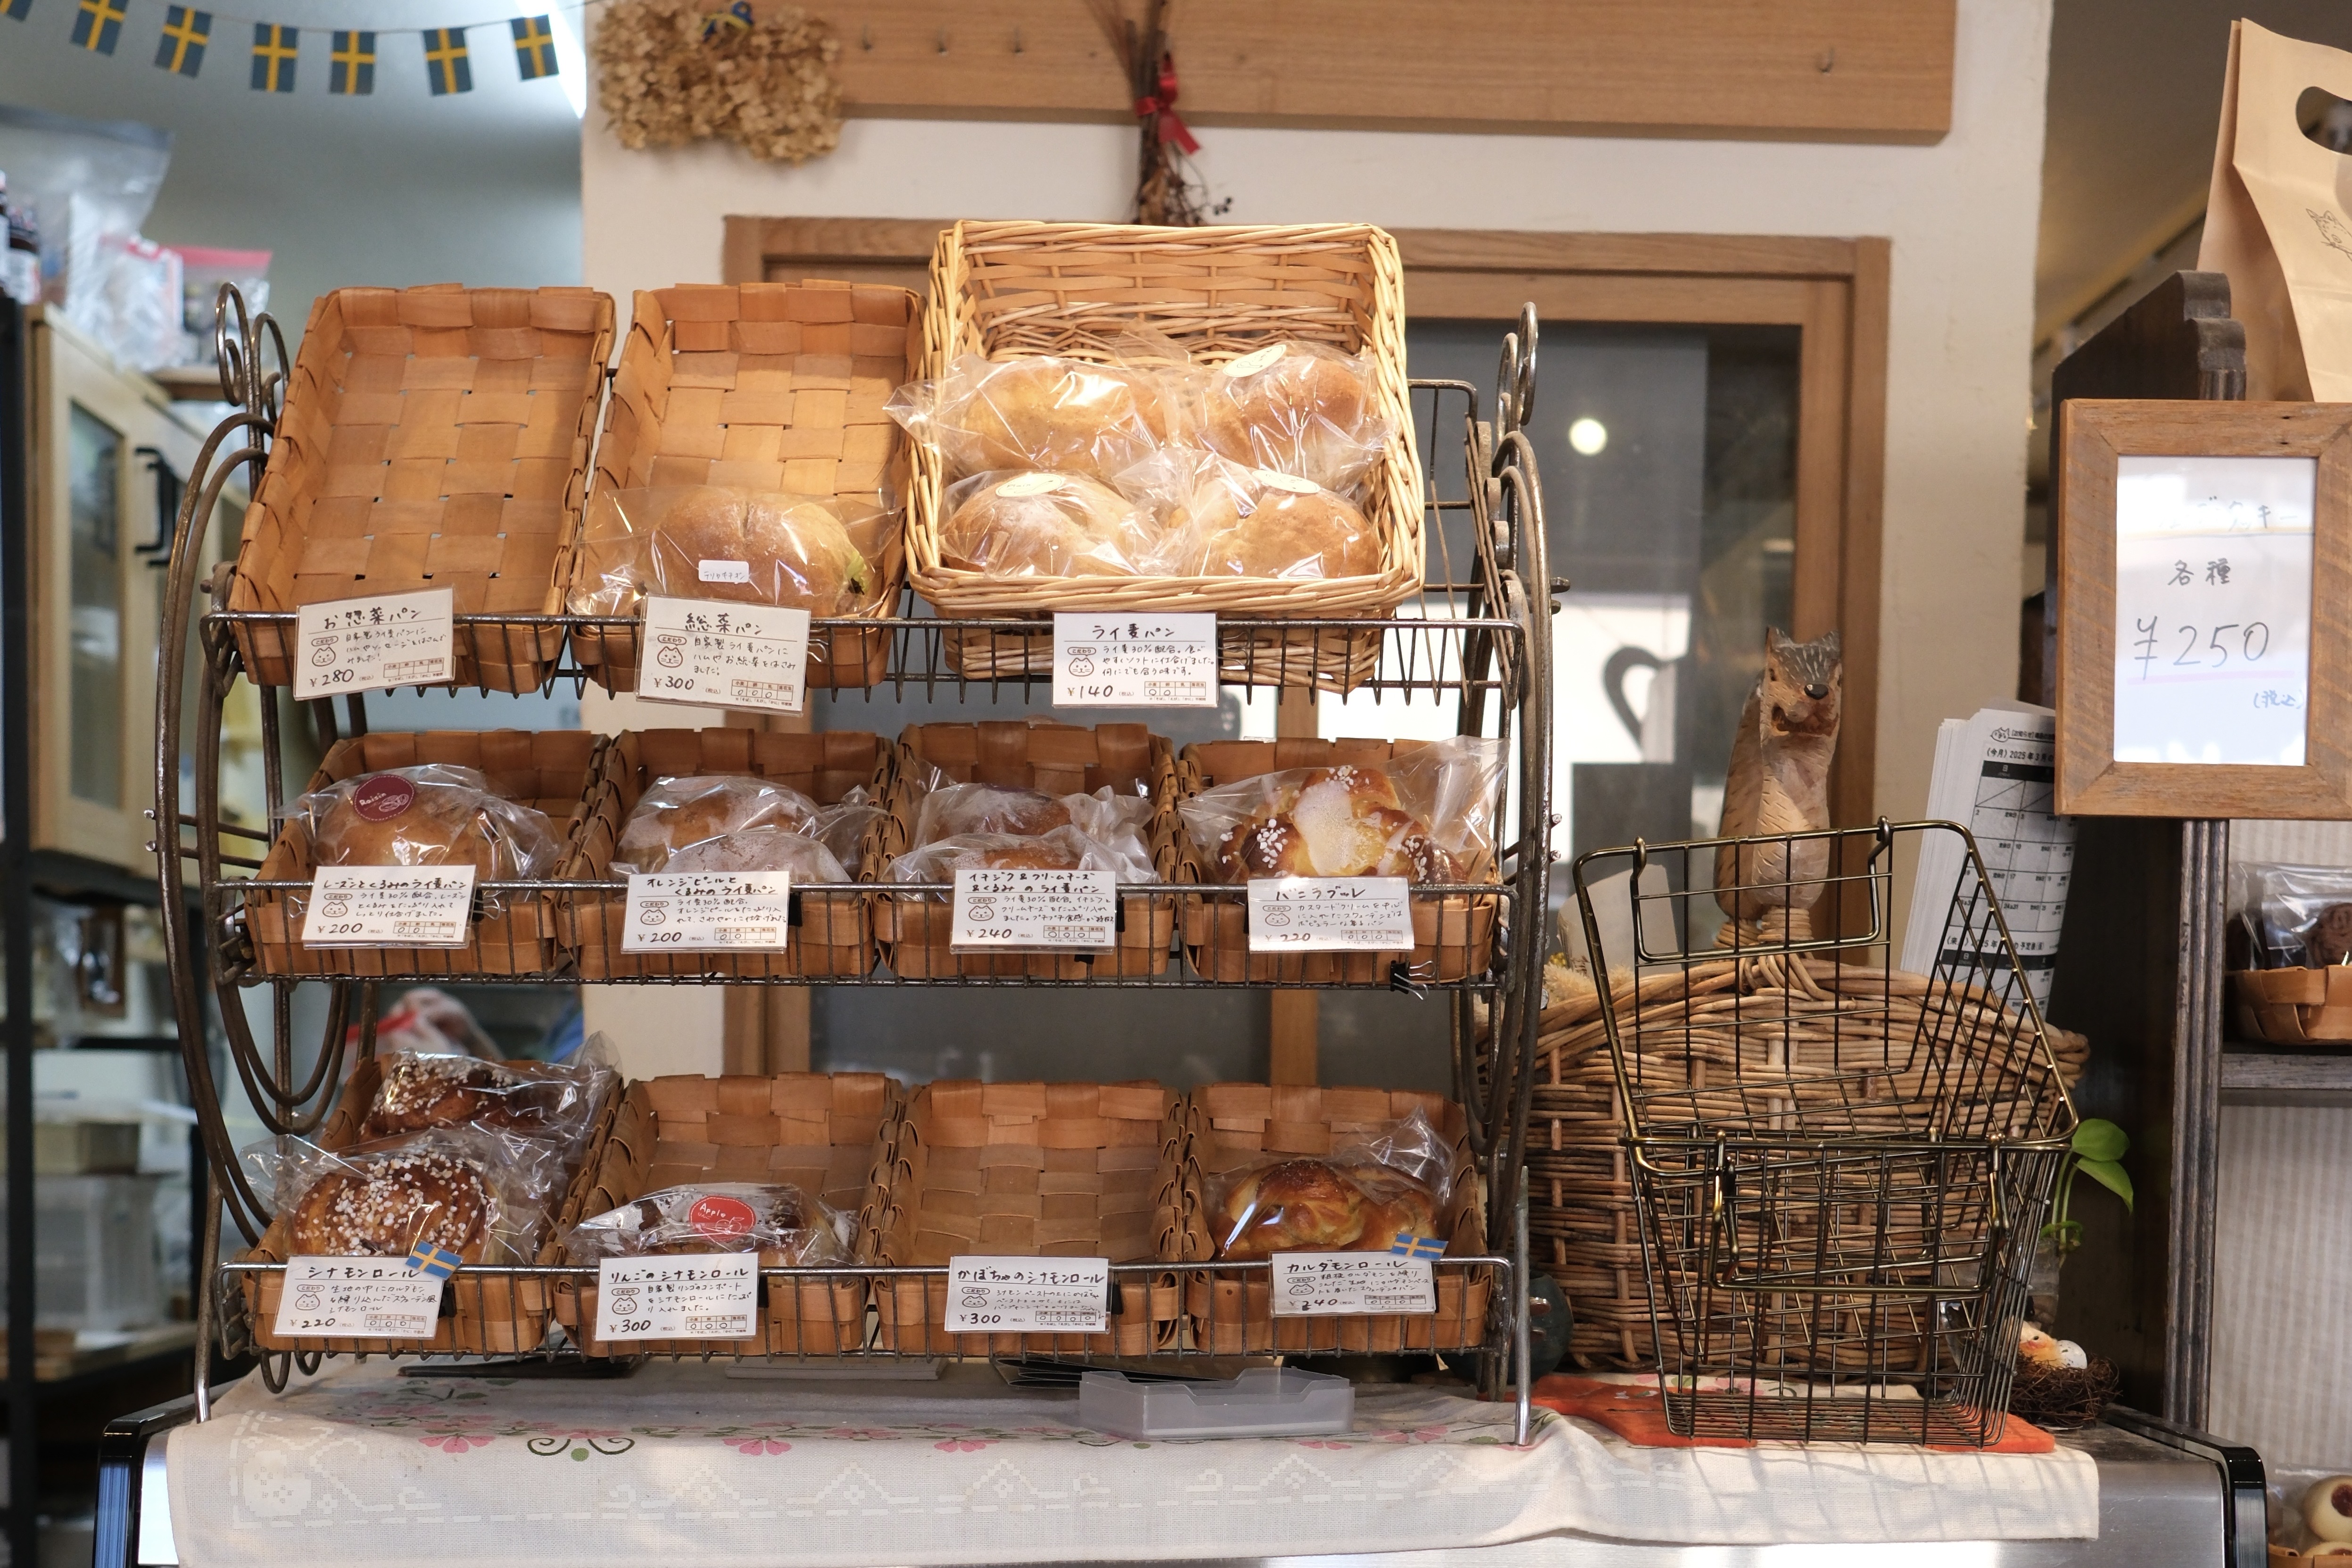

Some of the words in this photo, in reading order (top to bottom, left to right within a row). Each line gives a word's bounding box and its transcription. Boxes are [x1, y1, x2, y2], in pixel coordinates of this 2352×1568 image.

[2168, 558, 2230, 585] 各種
[325, 606, 421, 629] お惣菜パン
[685, 613, 762, 635] 総菜パン
[1093, 623, 1175, 640] ライ麦パン
[2134, 616, 2269, 680] ¥250
[310, 669, 354, 687] ¥280
[654, 676, 694, 690] ¥300
[1068, 685, 1113, 699] ¥140
[647, 876, 737, 887] オレンジピールと
[969, 872, 1095, 881] イチジク&クリームチーズ
[324, 878, 466, 889] レーズンとくるみのライ麦パン
[675, 883, 776, 895] くるみのライ麦パン
[318, 923, 363, 934] ¥200
[967, 929, 1012, 939] ¥240
[638, 932, 682, 943] ¥200
[1265, 933, 1311, 942] ¥220
[700, 1203, 726, 1218] Apple
[1287, 1260, 1408, 1272] カルダモンロール
[308, 1267, 420, 1279] シナモンロール
[612, 1268, 749, 1282] りんごのシナモンロール
[958, 1266, 1104, 1285] かぼちゃのシナモンロール
[290, 1319, 336, 1328] ¥220
[960, 1313, 1001, 1324] ¥300
[609, 1320, 651, 1333] ¥300
